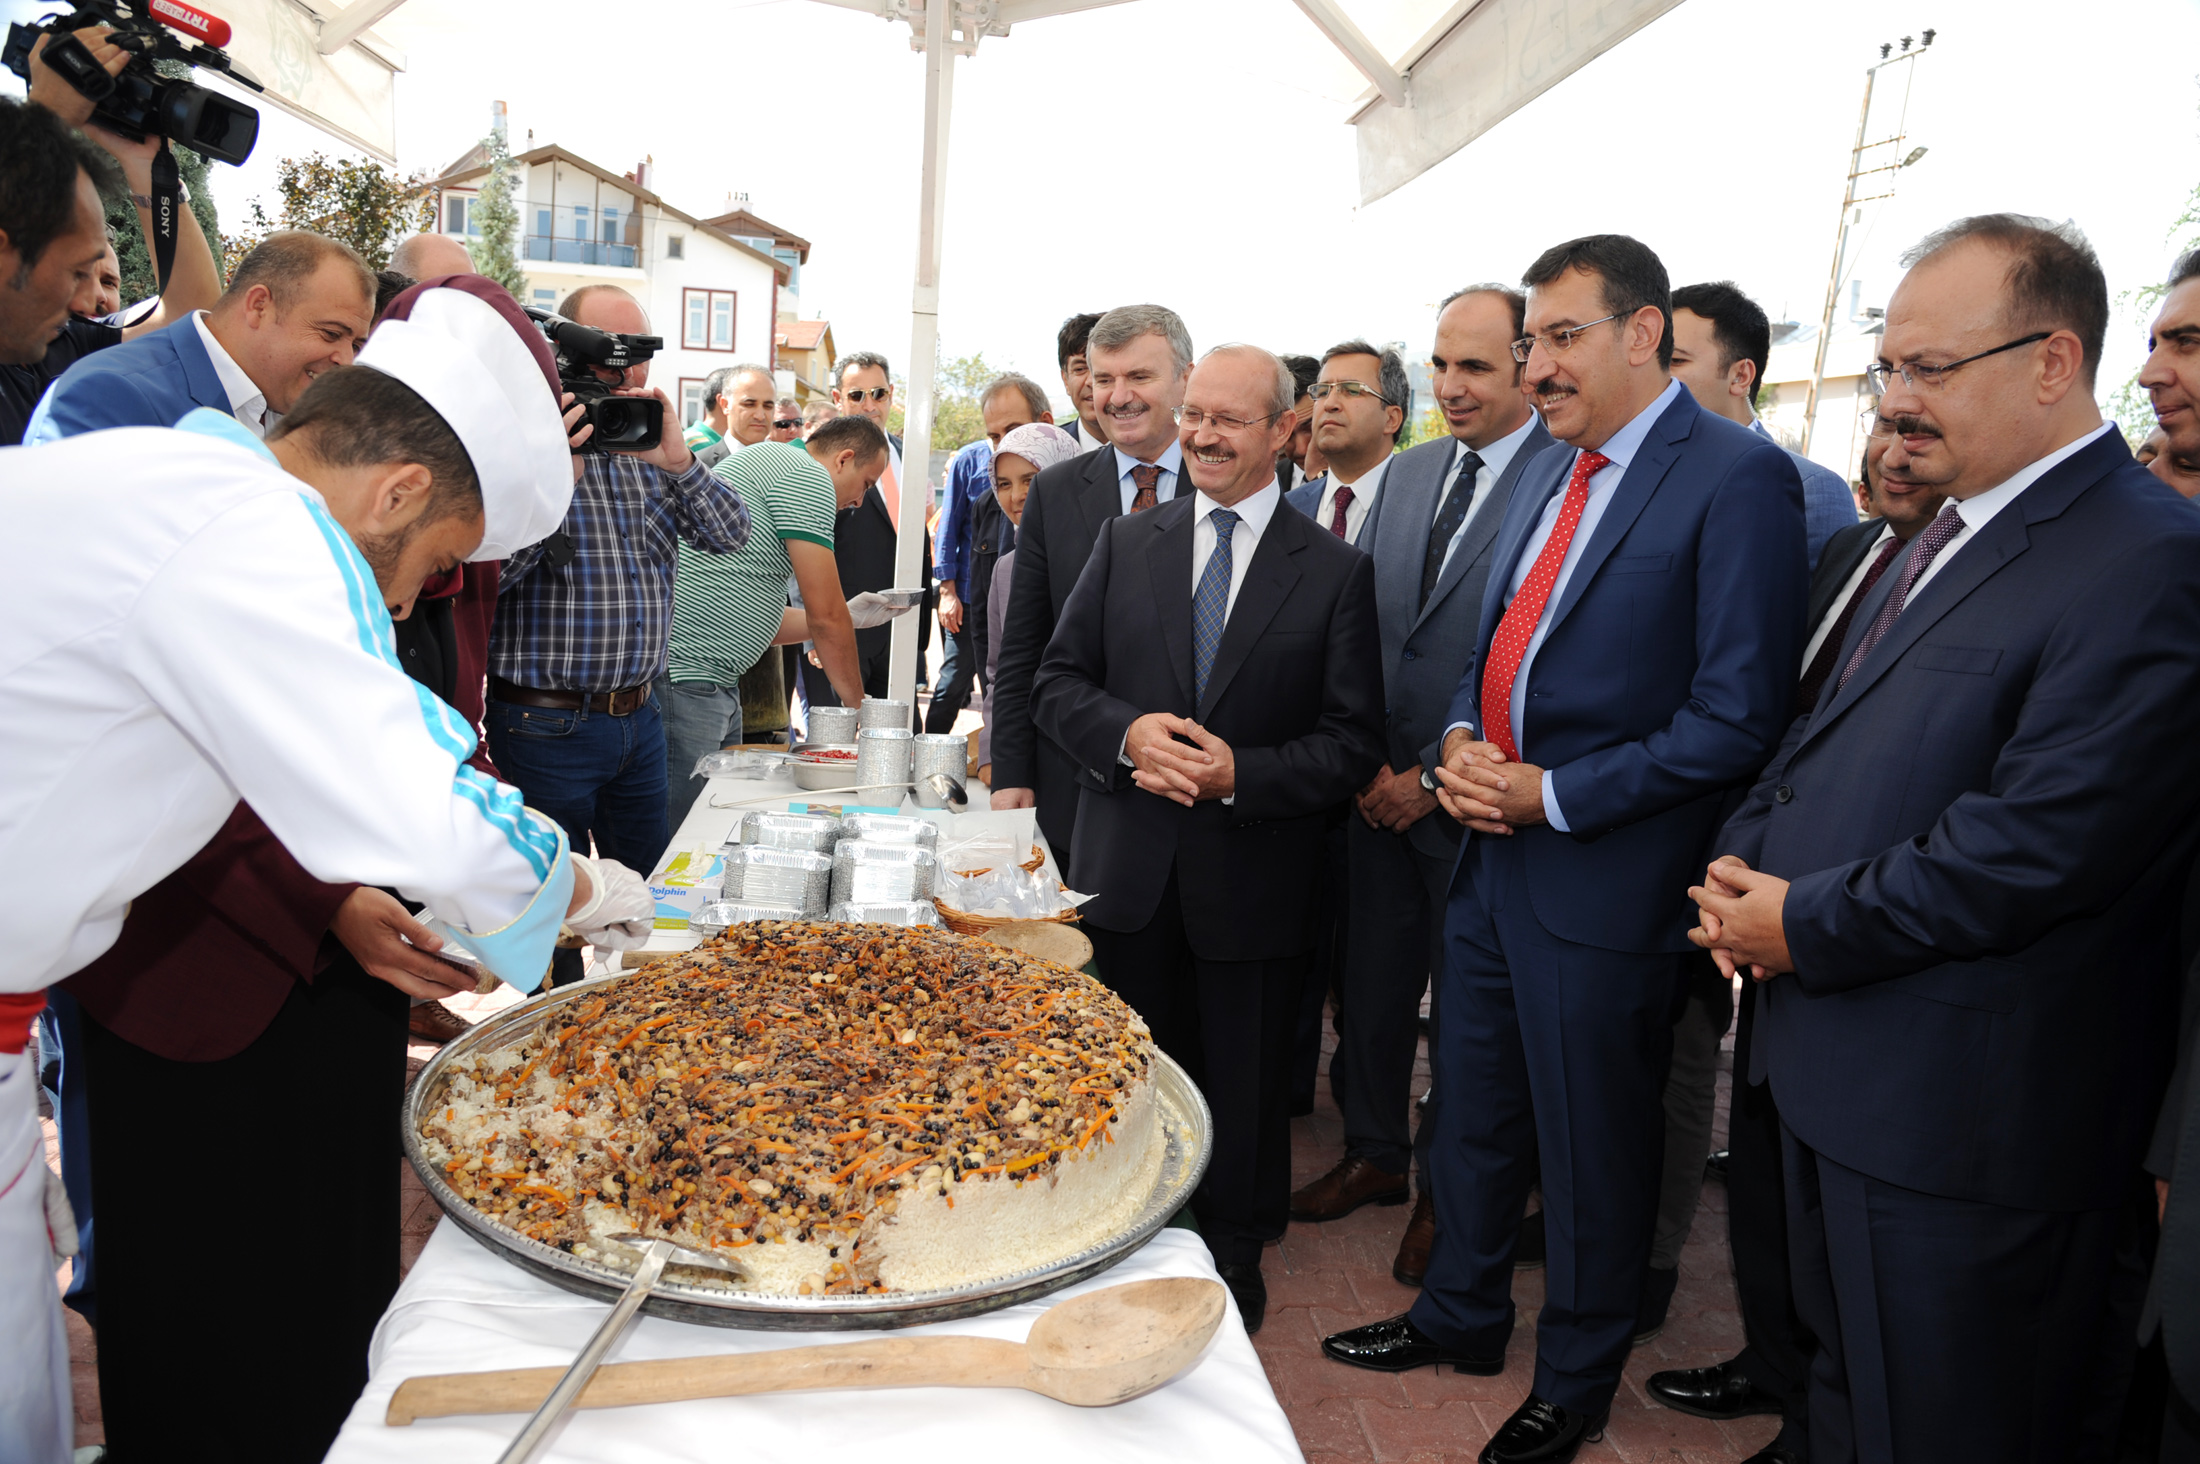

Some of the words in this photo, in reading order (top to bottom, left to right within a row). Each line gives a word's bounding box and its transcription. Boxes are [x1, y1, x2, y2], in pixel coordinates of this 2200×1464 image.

[154, 1, 184, 17] HABER
[182, 9, 209, 32] TRT
[160, 195, 171, 239] SONY
[648, 886, 687, 897] Dolphin
